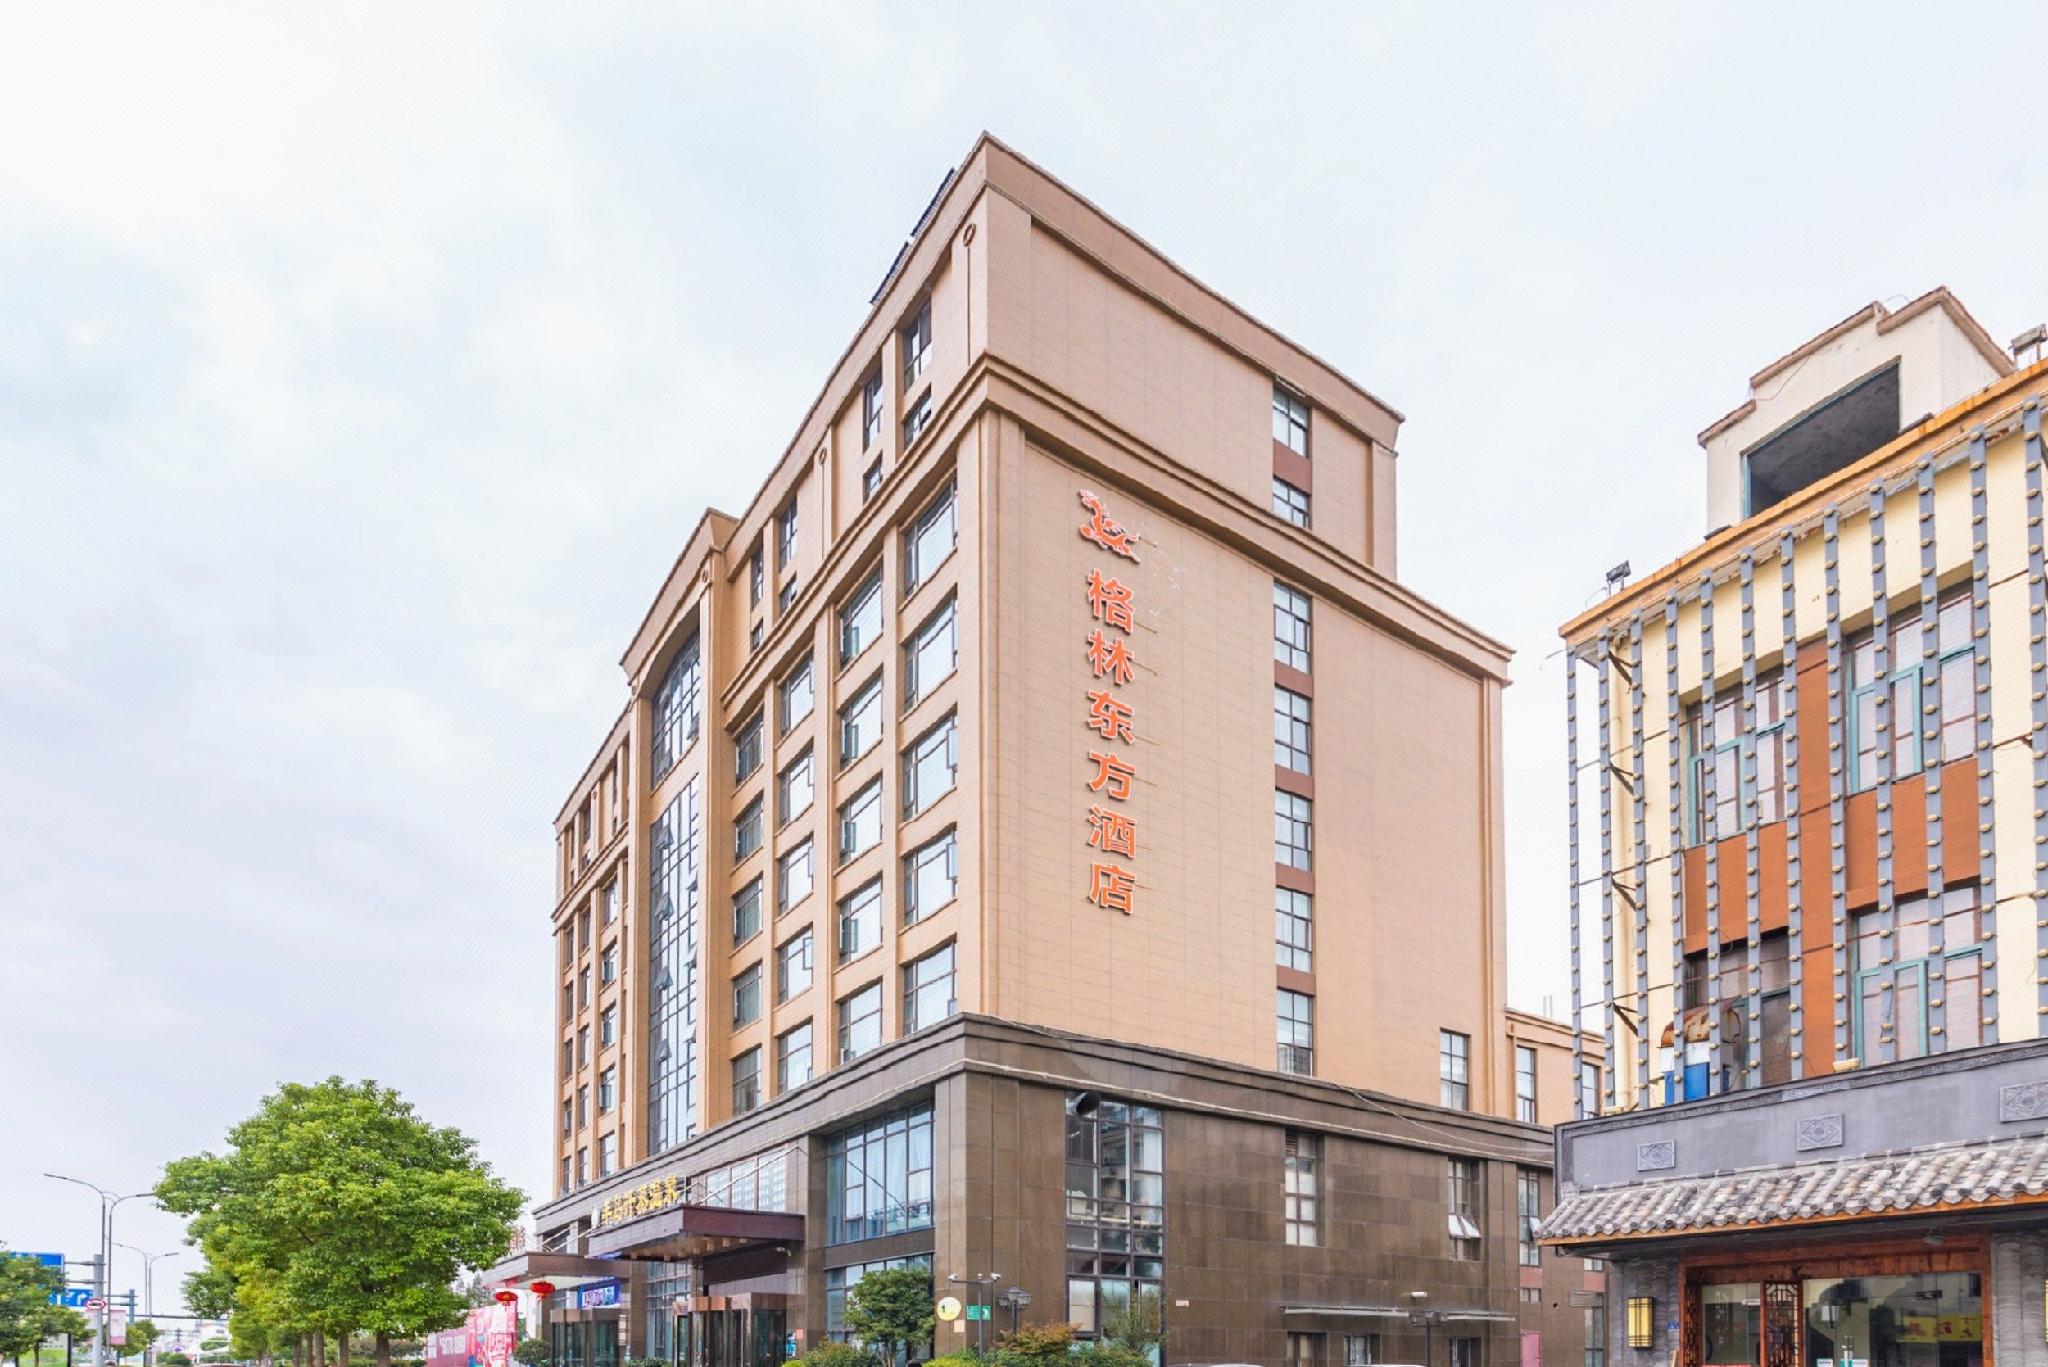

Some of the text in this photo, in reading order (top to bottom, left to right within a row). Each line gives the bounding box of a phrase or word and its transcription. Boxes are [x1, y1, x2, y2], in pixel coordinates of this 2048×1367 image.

[1087, 567, 1137, 915] 格林东方酒店
